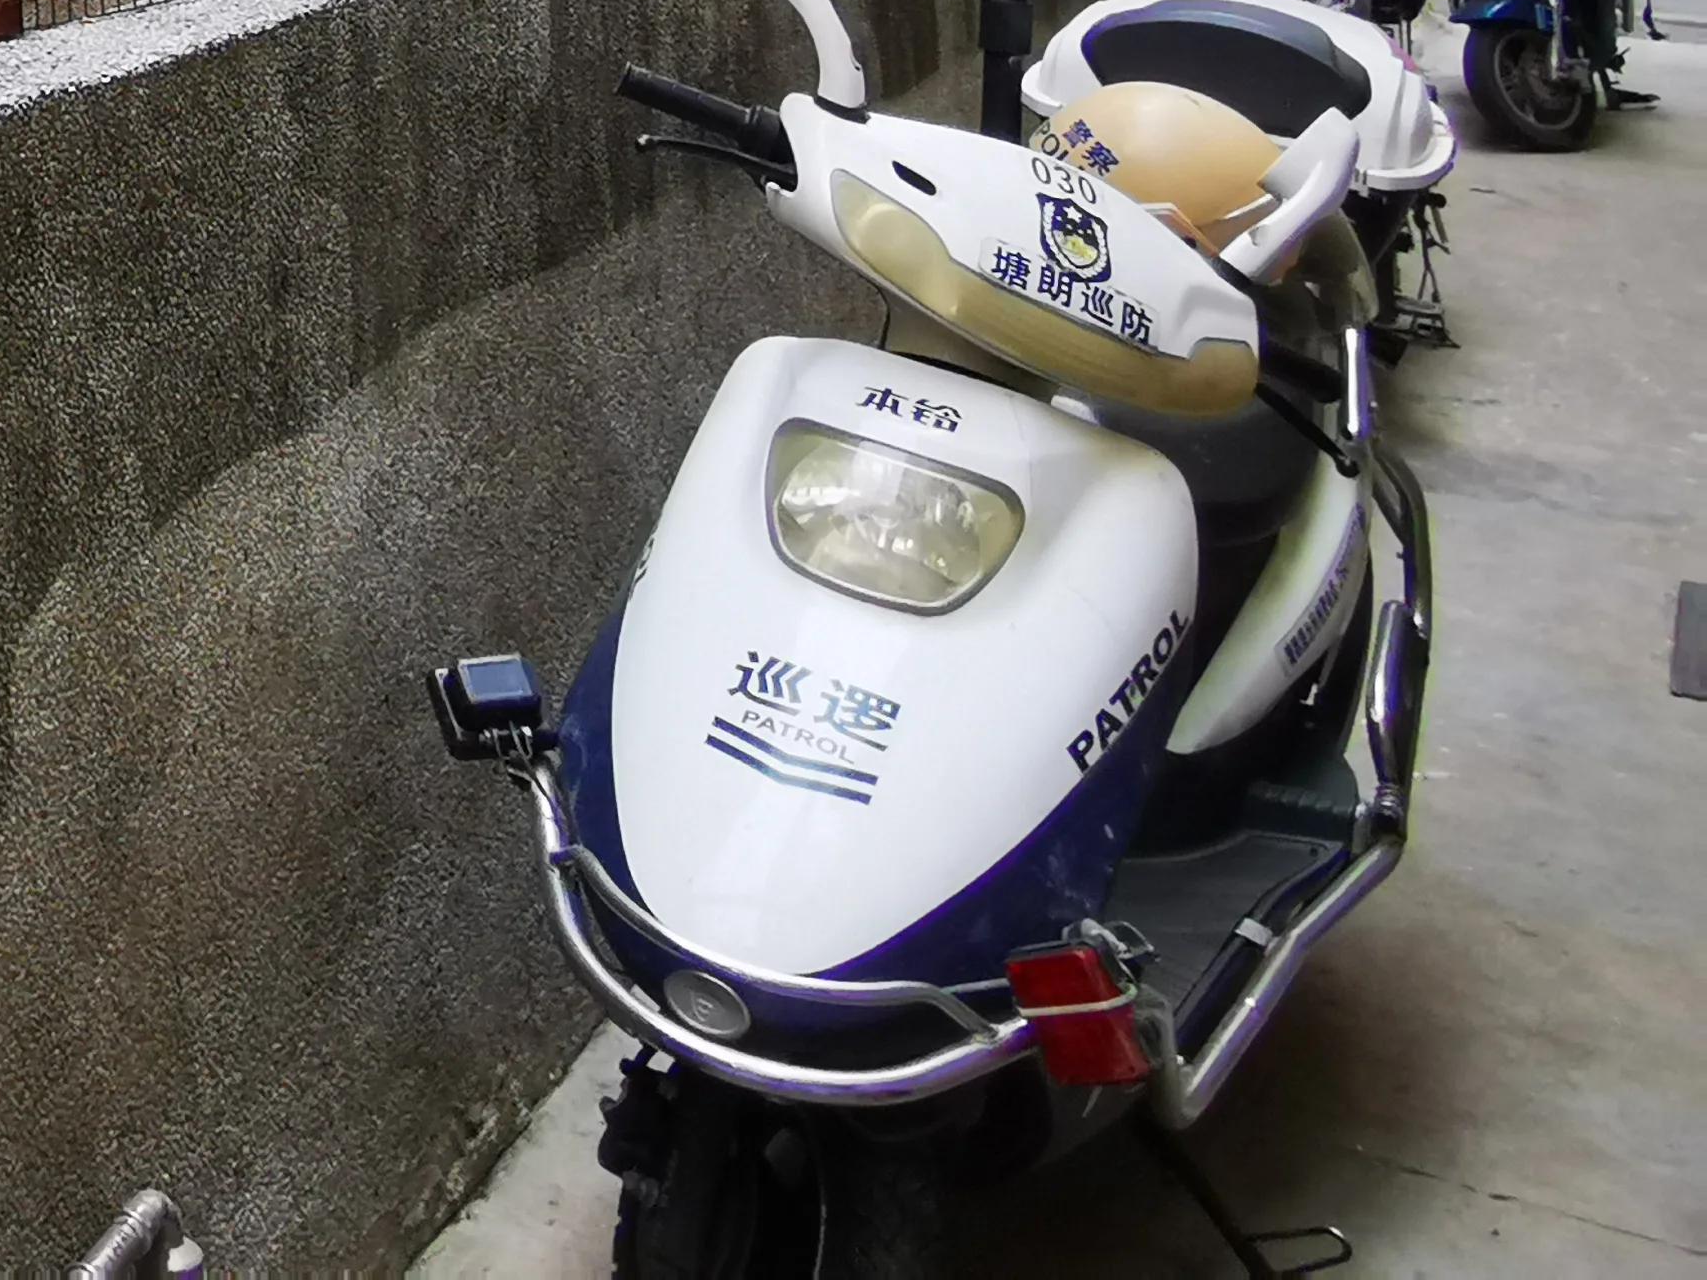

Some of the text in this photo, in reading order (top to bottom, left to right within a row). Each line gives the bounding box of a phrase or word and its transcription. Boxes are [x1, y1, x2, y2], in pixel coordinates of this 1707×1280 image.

[1031, 156, 1098, 205] 030
[1062, 119, 1119, 177] 警察
[991, 245, 1154, 346] 塘朗巡防
[726, 650, 902, 752] 巡逻
[1065, 609, 1190, 774] PATROL
[740, 709, 855, 765] PATROL
